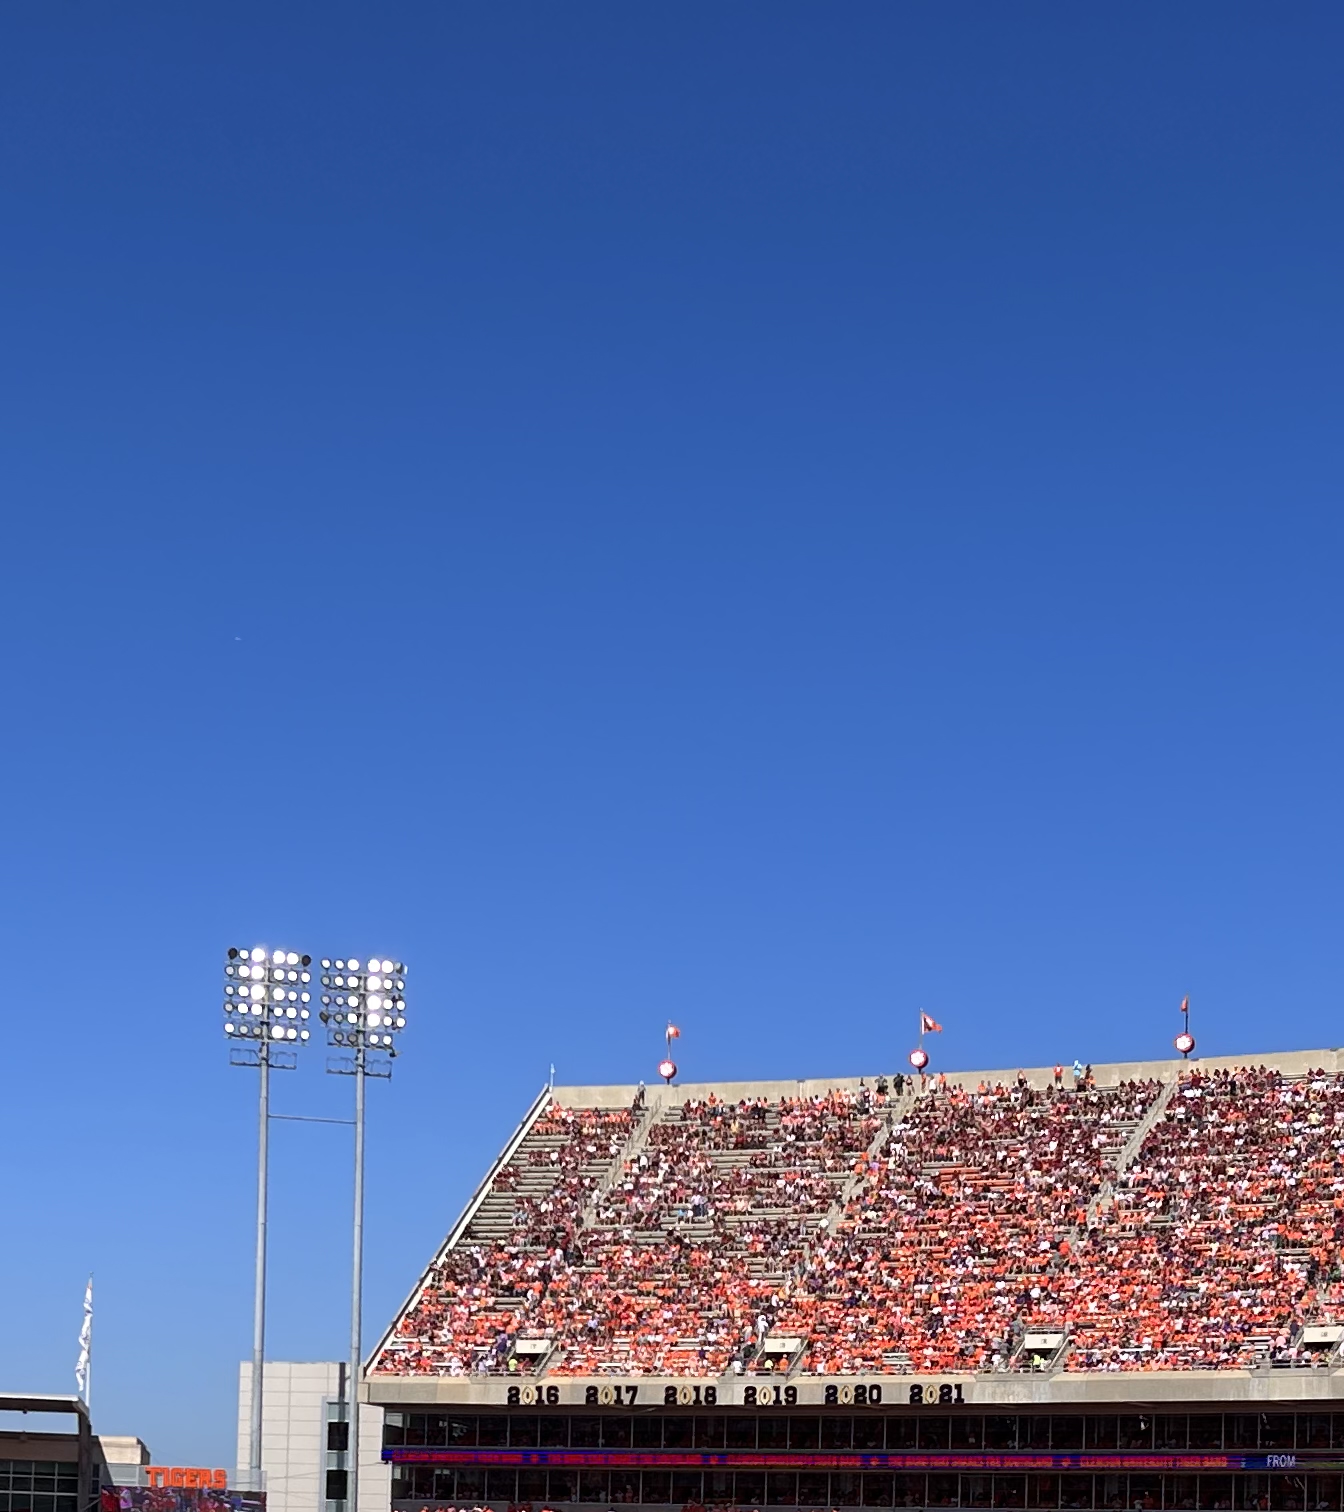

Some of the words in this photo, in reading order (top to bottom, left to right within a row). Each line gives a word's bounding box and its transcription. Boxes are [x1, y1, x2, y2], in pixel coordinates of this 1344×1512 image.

[507, 1385, 560, 1405] 2016
[585, 1385, 639, 1405] 2017
[664, 1385, 718, 1405] 2018
[743, 1385, 799, 1405] 2019
[824, 1384, 883, 1405] 2020
[909, 1383, 965, 1405] 2021
[145, 1466, 227, 1489] TIGERS
